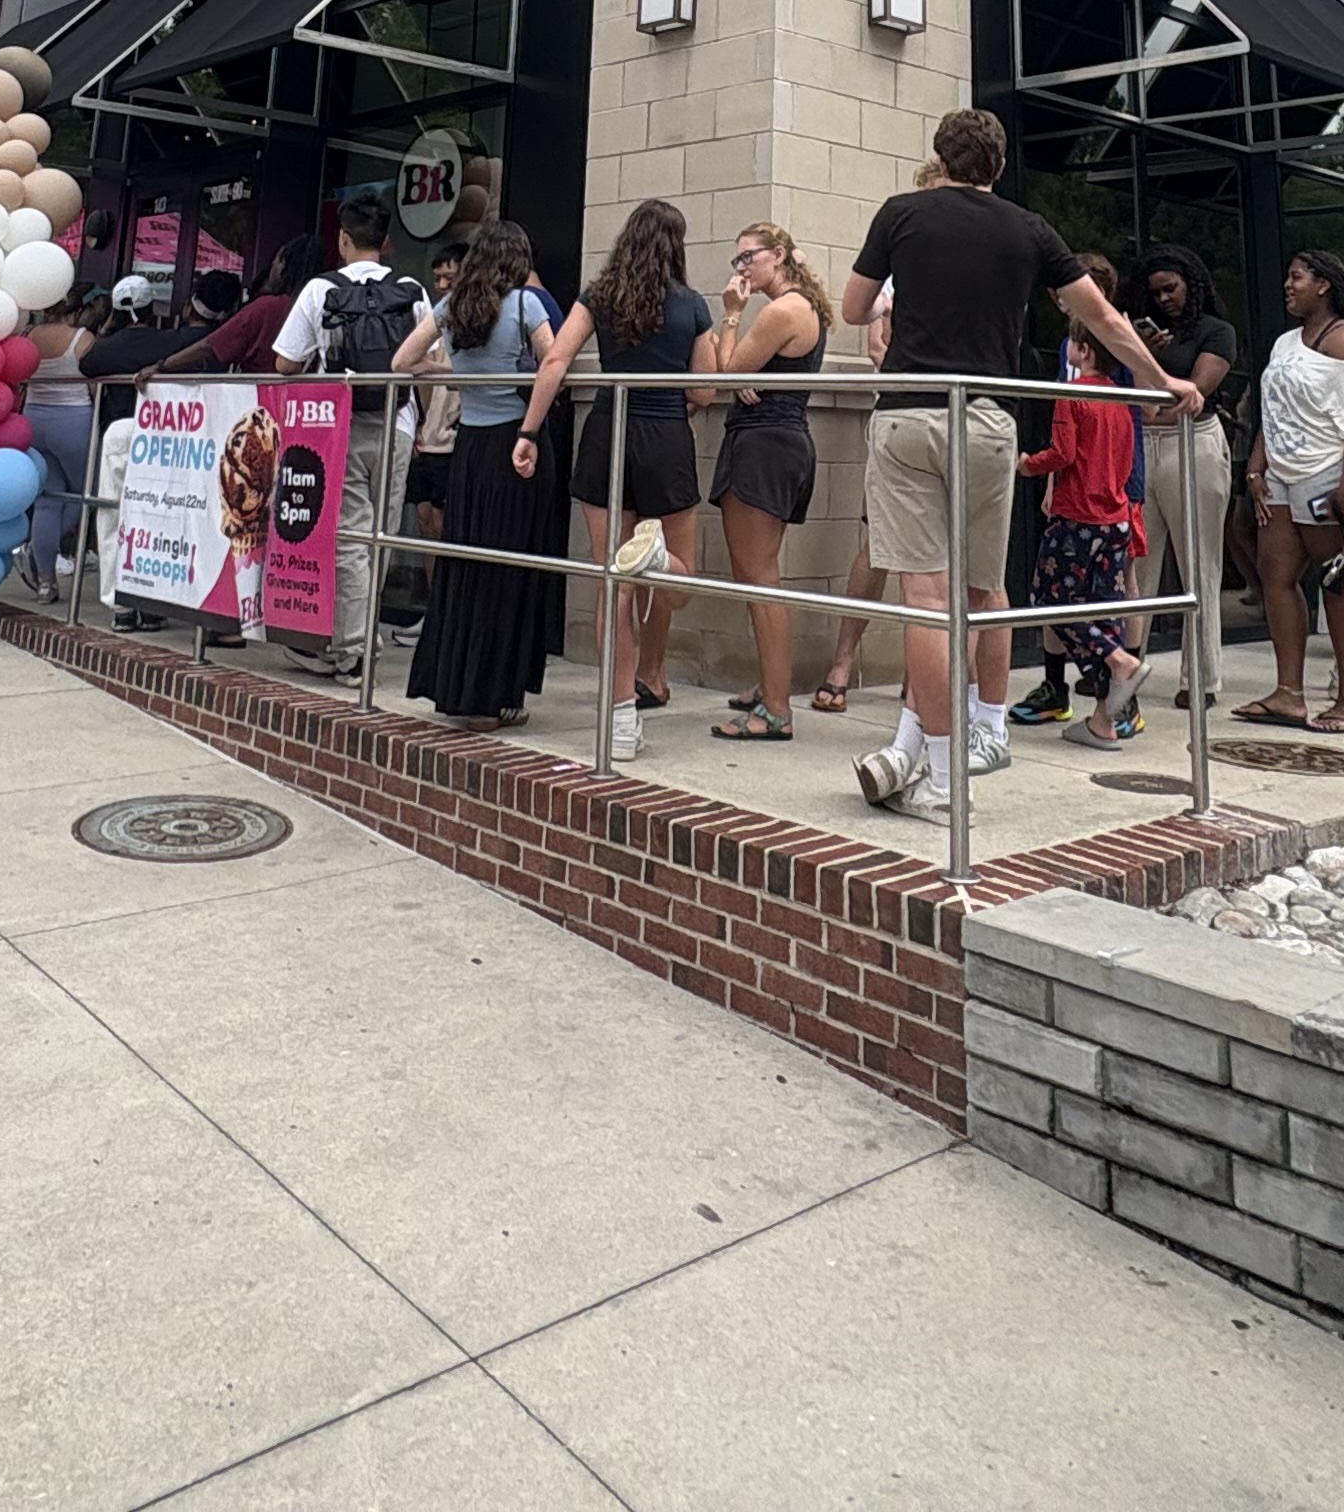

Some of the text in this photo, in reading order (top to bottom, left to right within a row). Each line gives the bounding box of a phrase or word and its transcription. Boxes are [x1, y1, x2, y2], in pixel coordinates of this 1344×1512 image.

[401, 159, 456, 206] BR
[138, 400, 205, 432] GRAND
[302, 400, 336, 423] BR
[131, 434, 216, 472] OPENING
[282, 467, 316, 487] 11am
[292, 492, 305, 504] to
[280, 507, 311, 526] 3pm
[152, 532, 190, 561] single
[266, 573, 321, 597] Giveaways
[273, 596, 320, 616] and More
